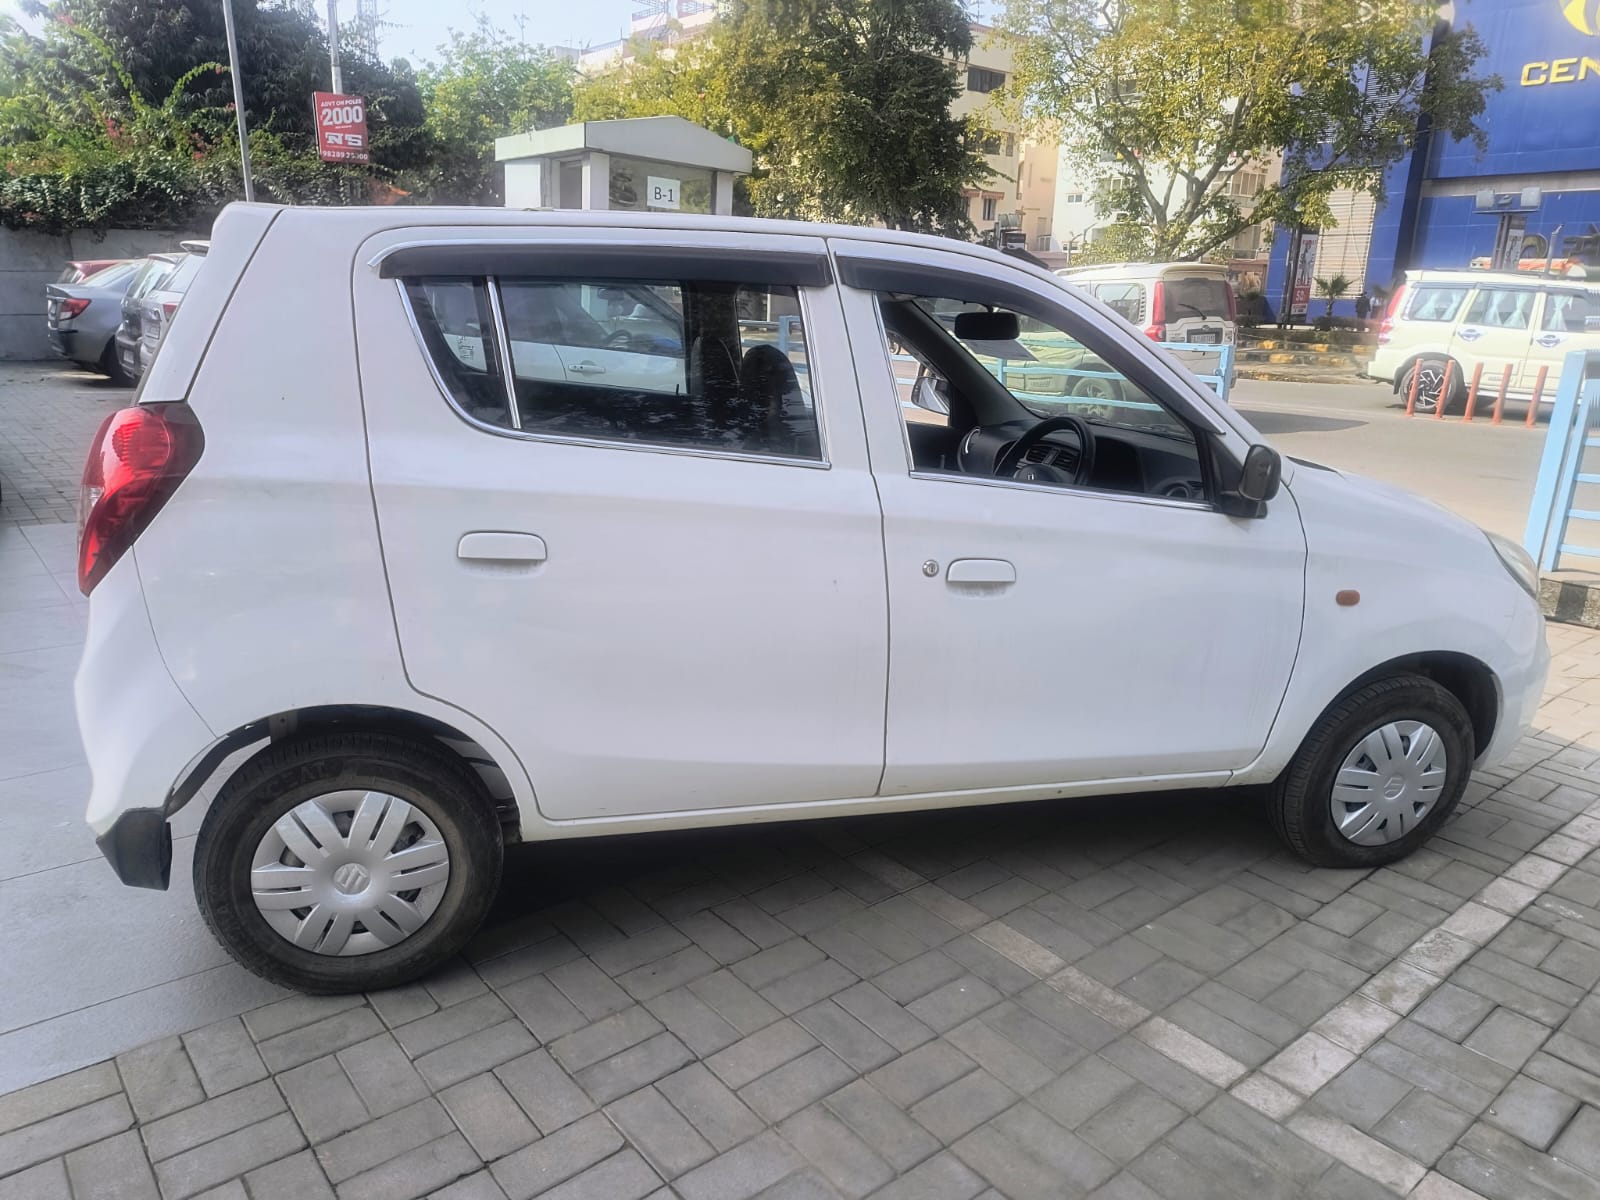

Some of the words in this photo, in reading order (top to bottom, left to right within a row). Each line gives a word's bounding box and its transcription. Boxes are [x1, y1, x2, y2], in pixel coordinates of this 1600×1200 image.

[1520, 56, 1600, 87] CEN
[322, 105, 363, 126] 2000
[654, 186, 674, 202] B-1
